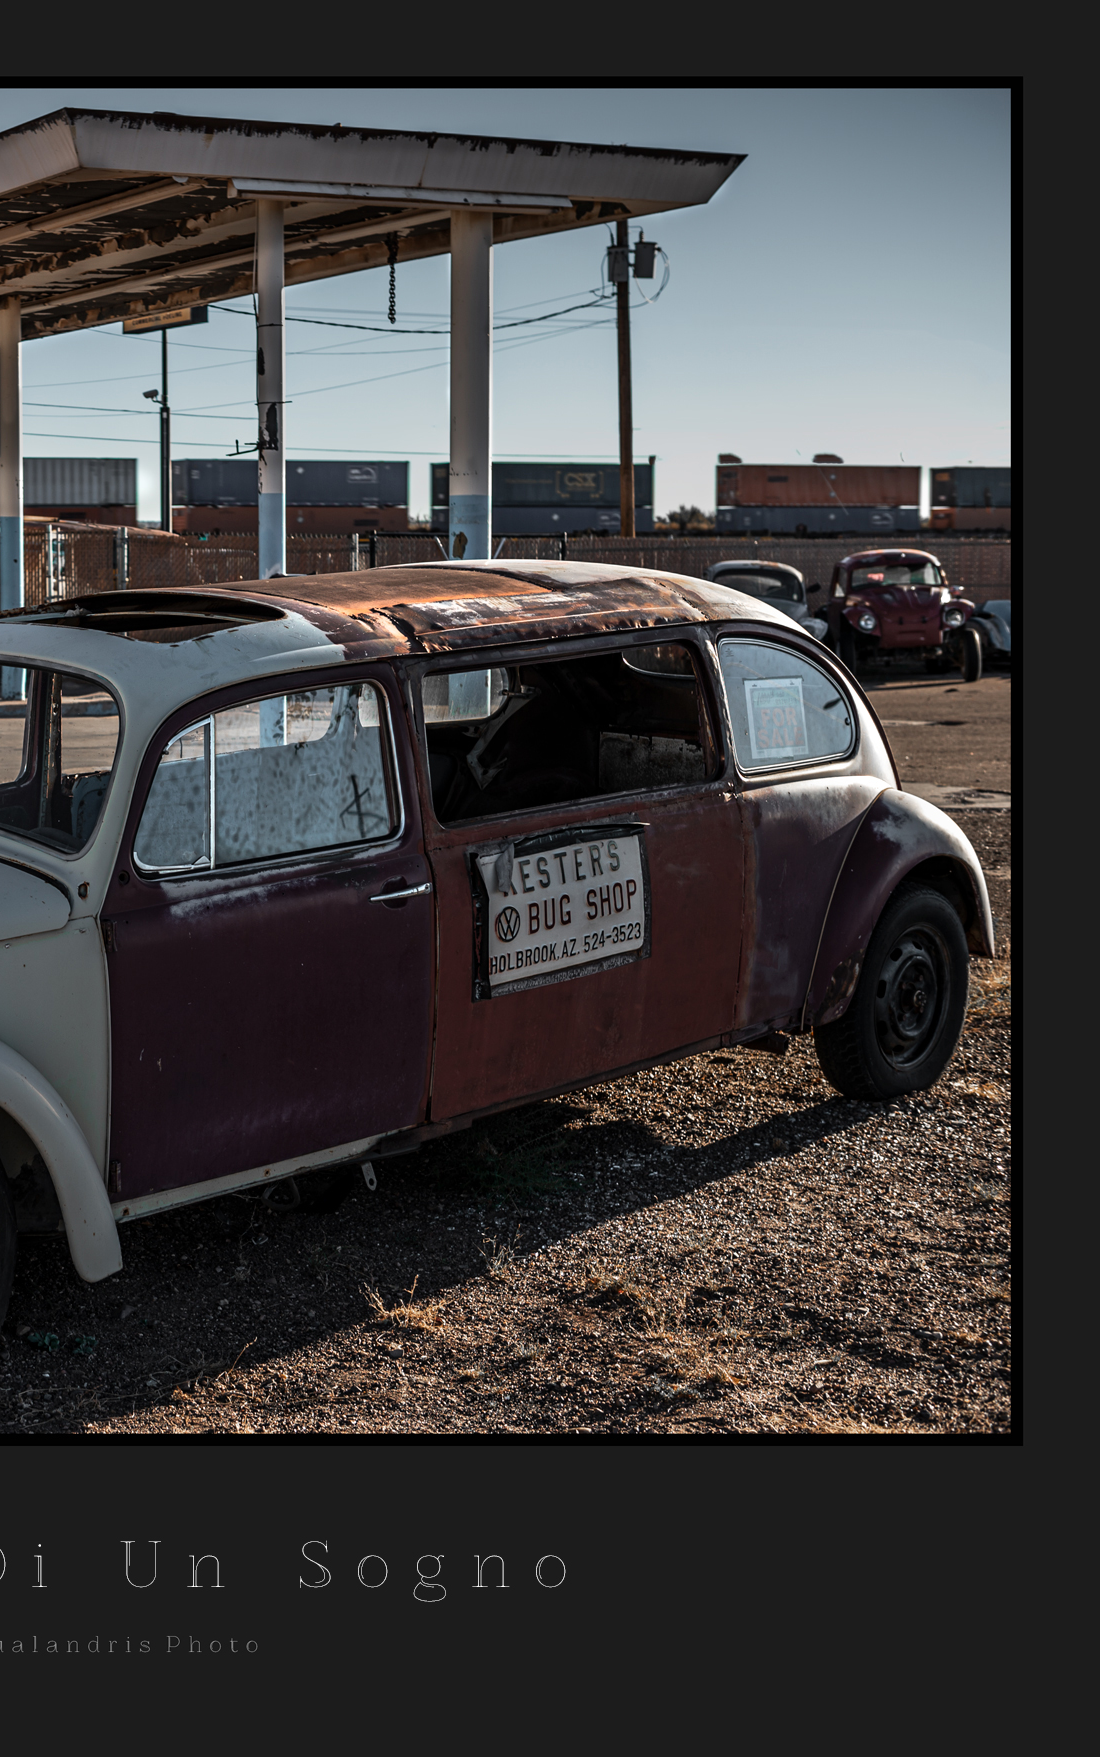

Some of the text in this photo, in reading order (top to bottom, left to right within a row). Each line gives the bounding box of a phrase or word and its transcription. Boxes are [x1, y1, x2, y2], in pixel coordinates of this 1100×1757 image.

[760, 707, 798, 728] FOR
[757, 726, 805, 748] SALE
[528, 894, 571, 935] BUG
[586, 878, 638, 920] SHOP
[583, 922, 642, 952] 524-3523
